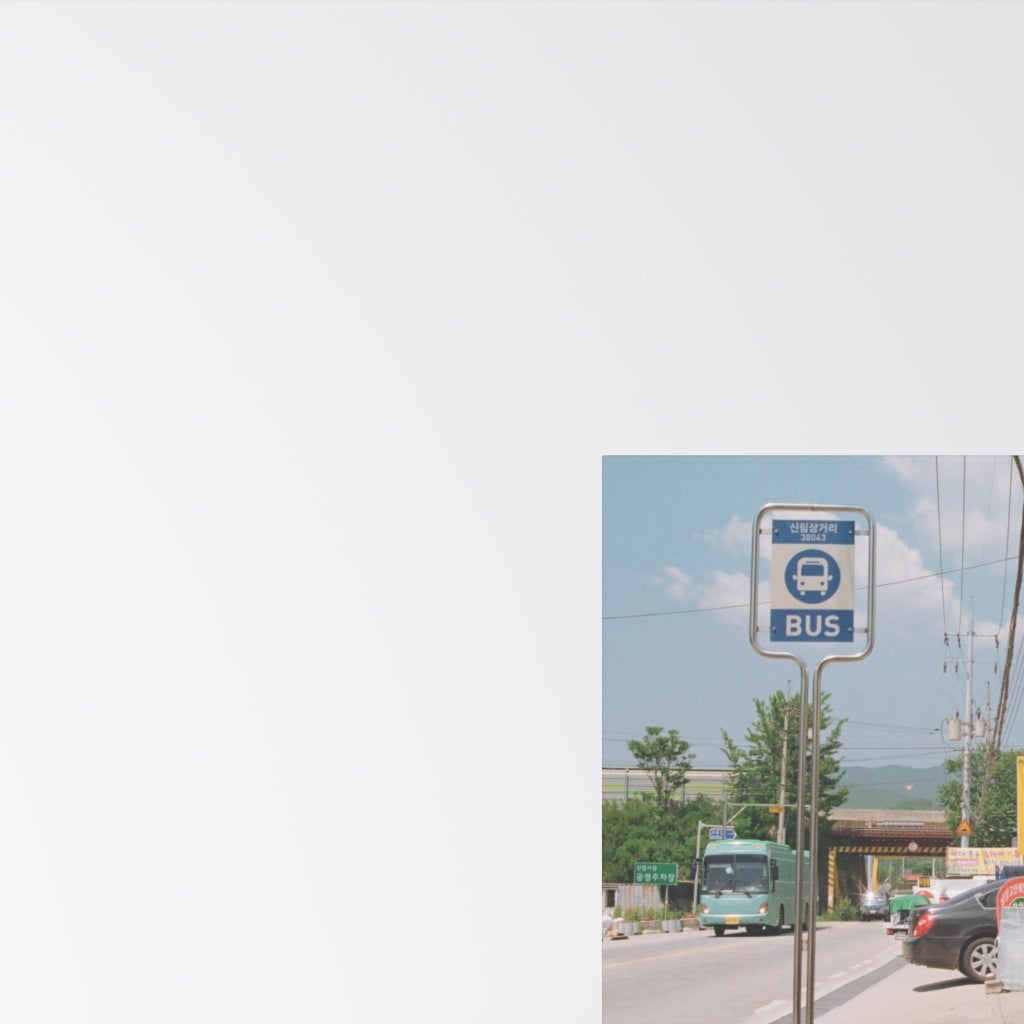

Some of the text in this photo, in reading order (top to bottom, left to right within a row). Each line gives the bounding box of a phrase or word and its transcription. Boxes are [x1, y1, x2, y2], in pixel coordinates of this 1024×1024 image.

[789, 522, 838, 534] 신림삼거리
[801, 533, 827, 542] 38043
[785, 614, 841, 638] BUS
